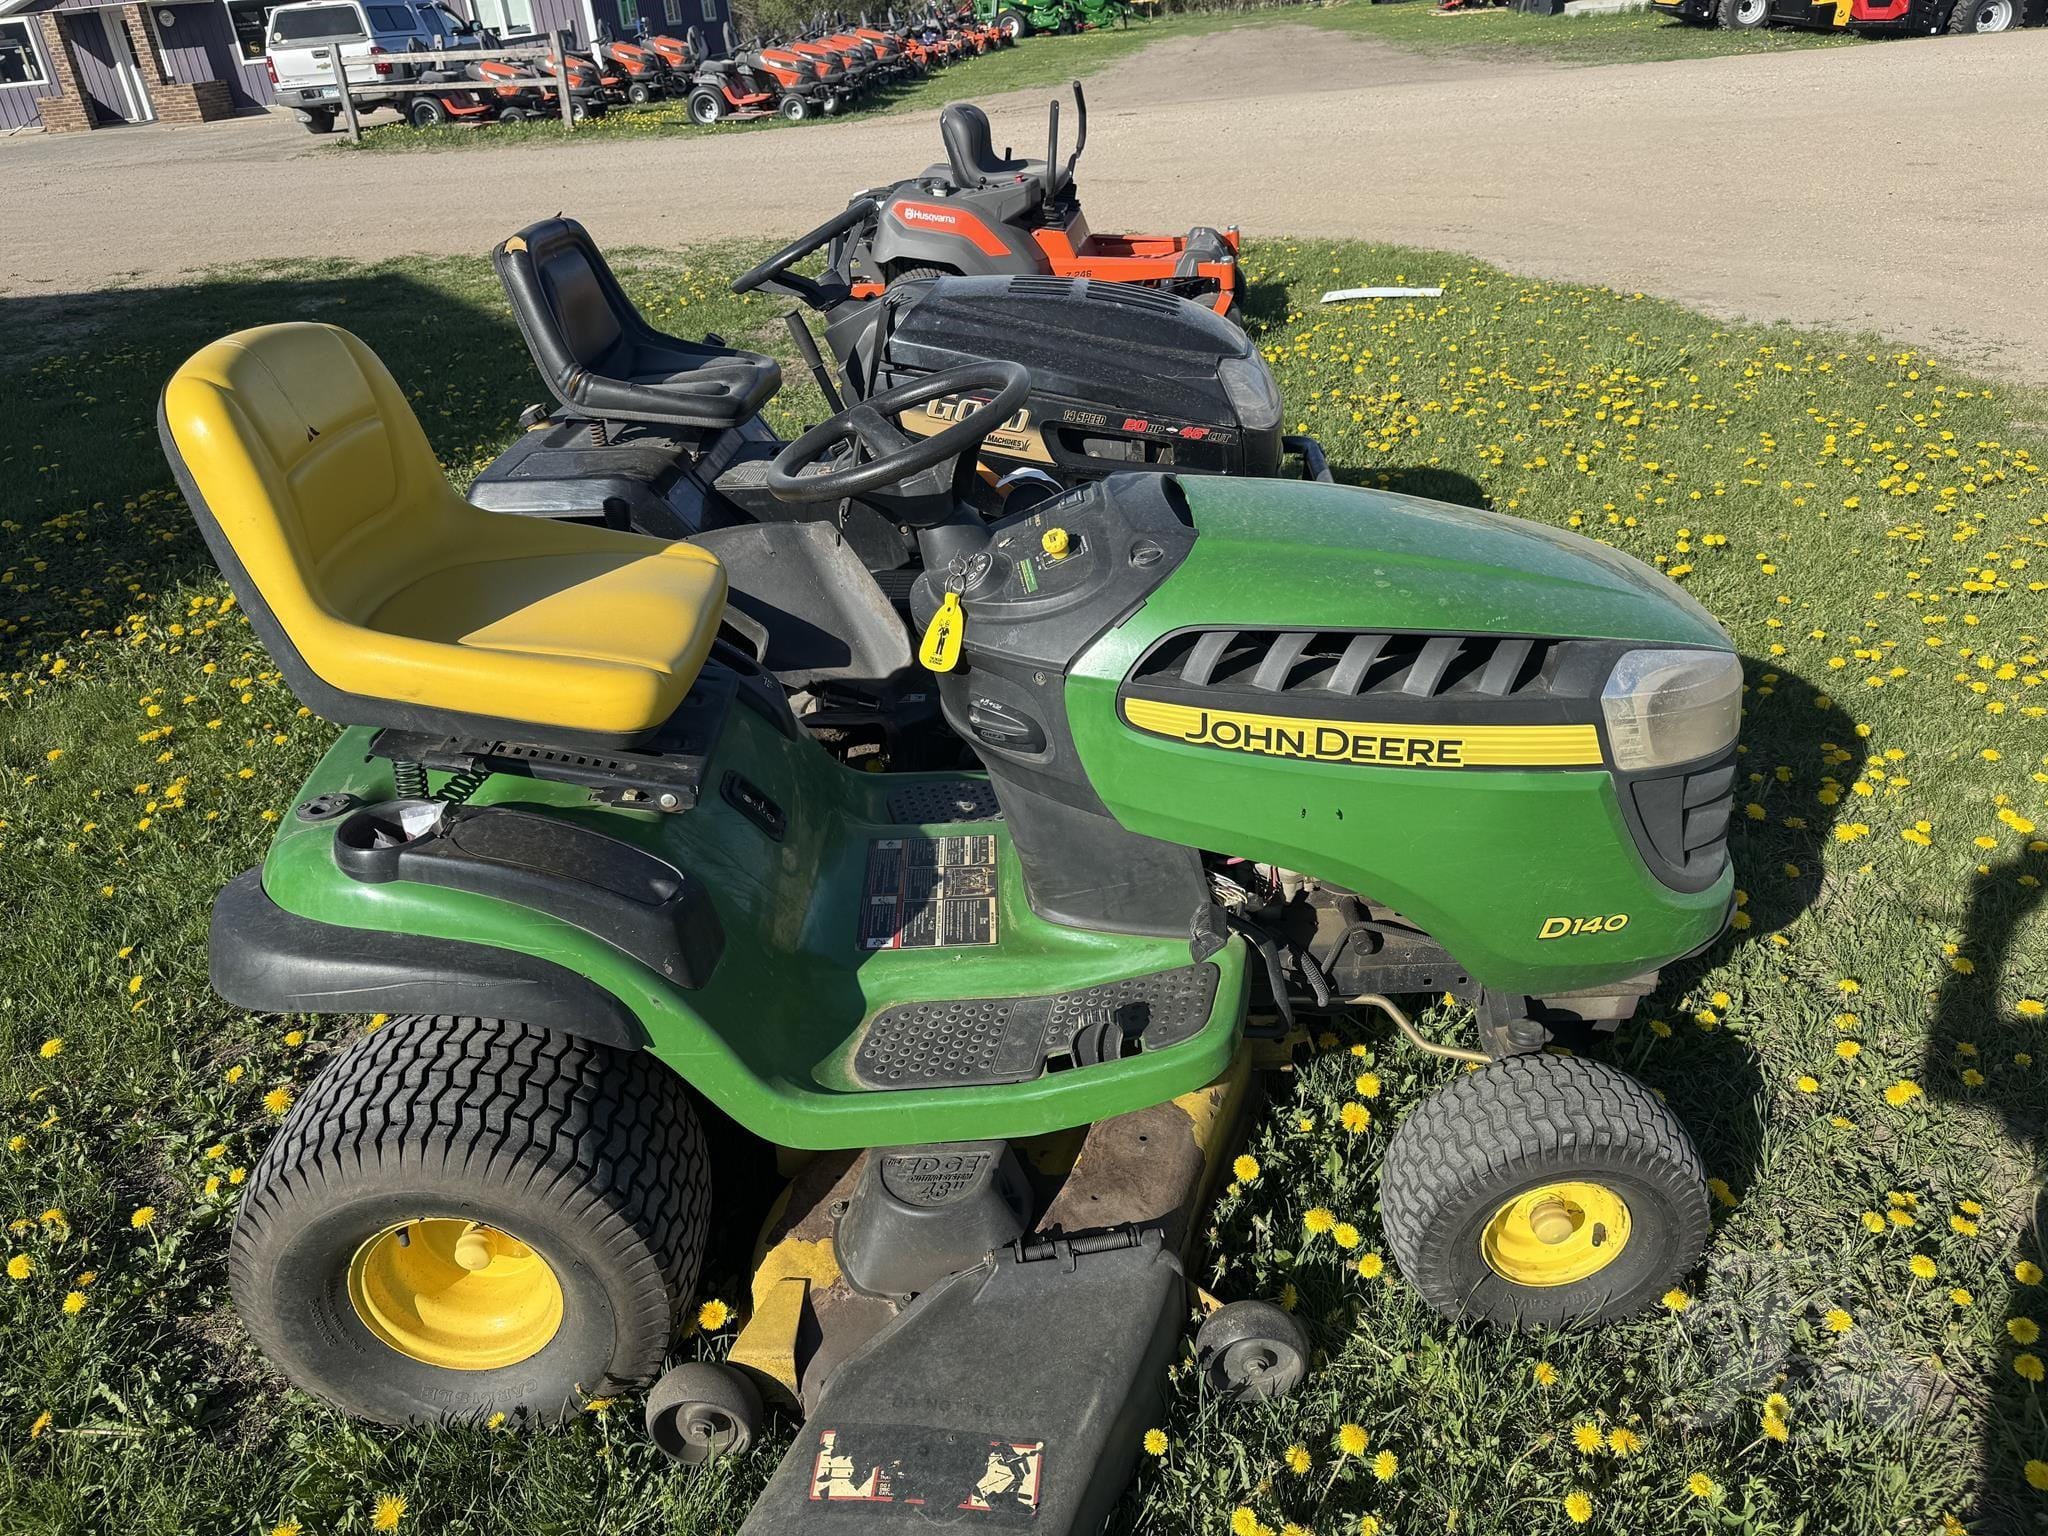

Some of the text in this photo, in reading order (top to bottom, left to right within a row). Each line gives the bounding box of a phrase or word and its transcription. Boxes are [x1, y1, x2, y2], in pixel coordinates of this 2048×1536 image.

[913, 209, 956, 224] Husqvarna
[1074, 270, 1092, 278] 246
[1063, 409, 1107, 426] 14 SPEED
[987, 434, 1022, 447] MACHINES
[1185, 712, 1463, 764] JOHN DEERE
[1538, 913, 1630, 940] D140
[899, 1156, 981, 1176] EDGE
[941, 1172, 974, 1182] SYSTEM
[420, 1377, 538, 1403] CARLISLE
